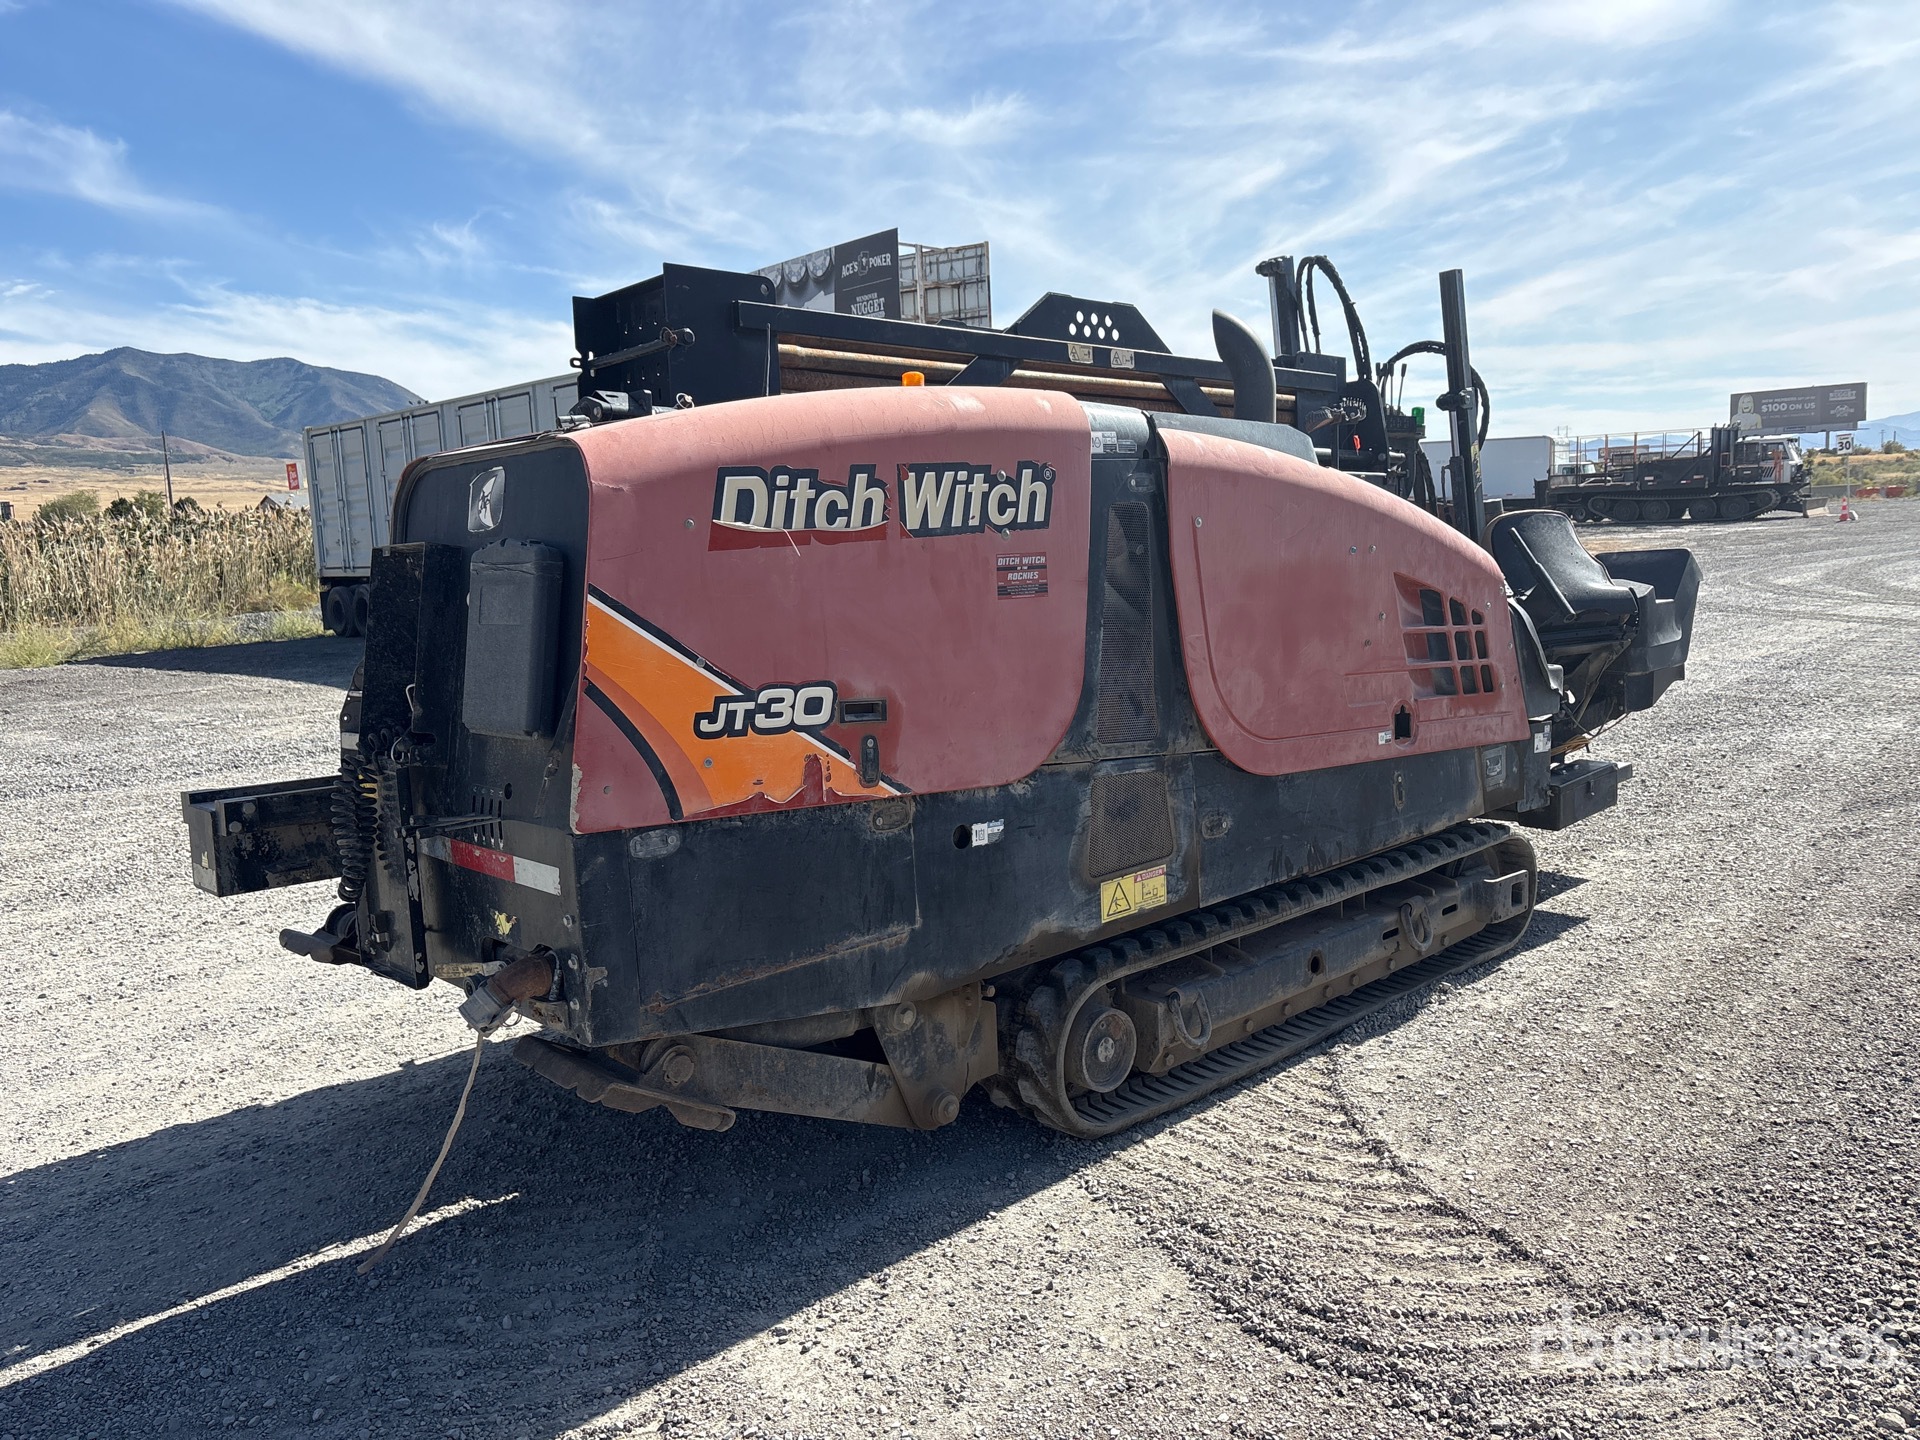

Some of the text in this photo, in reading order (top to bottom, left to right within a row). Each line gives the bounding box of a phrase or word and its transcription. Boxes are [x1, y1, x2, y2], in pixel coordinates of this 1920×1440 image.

[841, 253, 891, 278] ACE'S POKER
[851, 298, 885, 315] NUGGET
[1761, 402, 1788, 413] $100
[1804, 402, 1816, 410] US
[1838, 441, 1851, 451] 30
[720, 474, 886, 530] Ditch
[997, 557, 1020, 566] DITCH
[1022, 555, 1046, 565] WITCH
[1007, 571, 1039, 581] ROCKIES
[700, 686, 834, 733] JT30
[1141, 868, 1163, 880] DANGER
